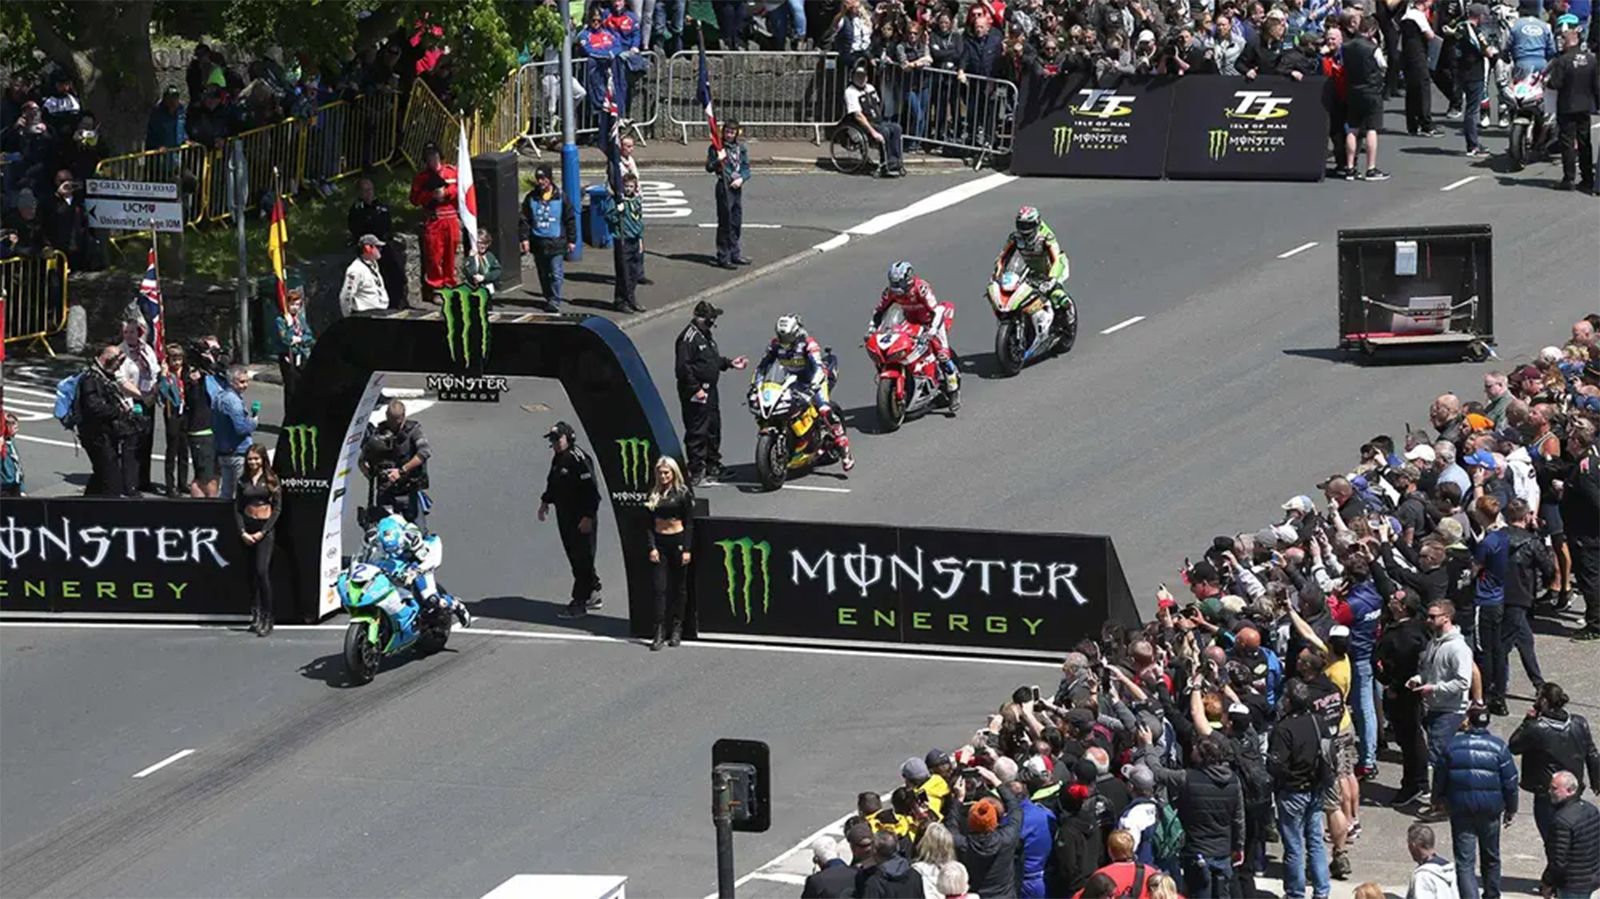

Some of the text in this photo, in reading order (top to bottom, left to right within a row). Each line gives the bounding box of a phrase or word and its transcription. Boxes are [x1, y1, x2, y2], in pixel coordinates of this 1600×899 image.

[1234, 90, 1293, 121] TT
[1073, 133, 1128, 144] MONSTER
[1229, 135, 1285, 146] MONSTER
[100, 182, 176, 193] GREENFIELD ROAD
[100, 216, 136, 227] University
[427, 375, 508, 391] MONSTER
[440, 392, 497, 400] ENERGY
[612, 491, 648, 501] MONST
[0, 516, 229, 569] ONSTER
[790, 543, 1089, 605] MONSTER
[837, 607, 1045, 636] ENERGY
